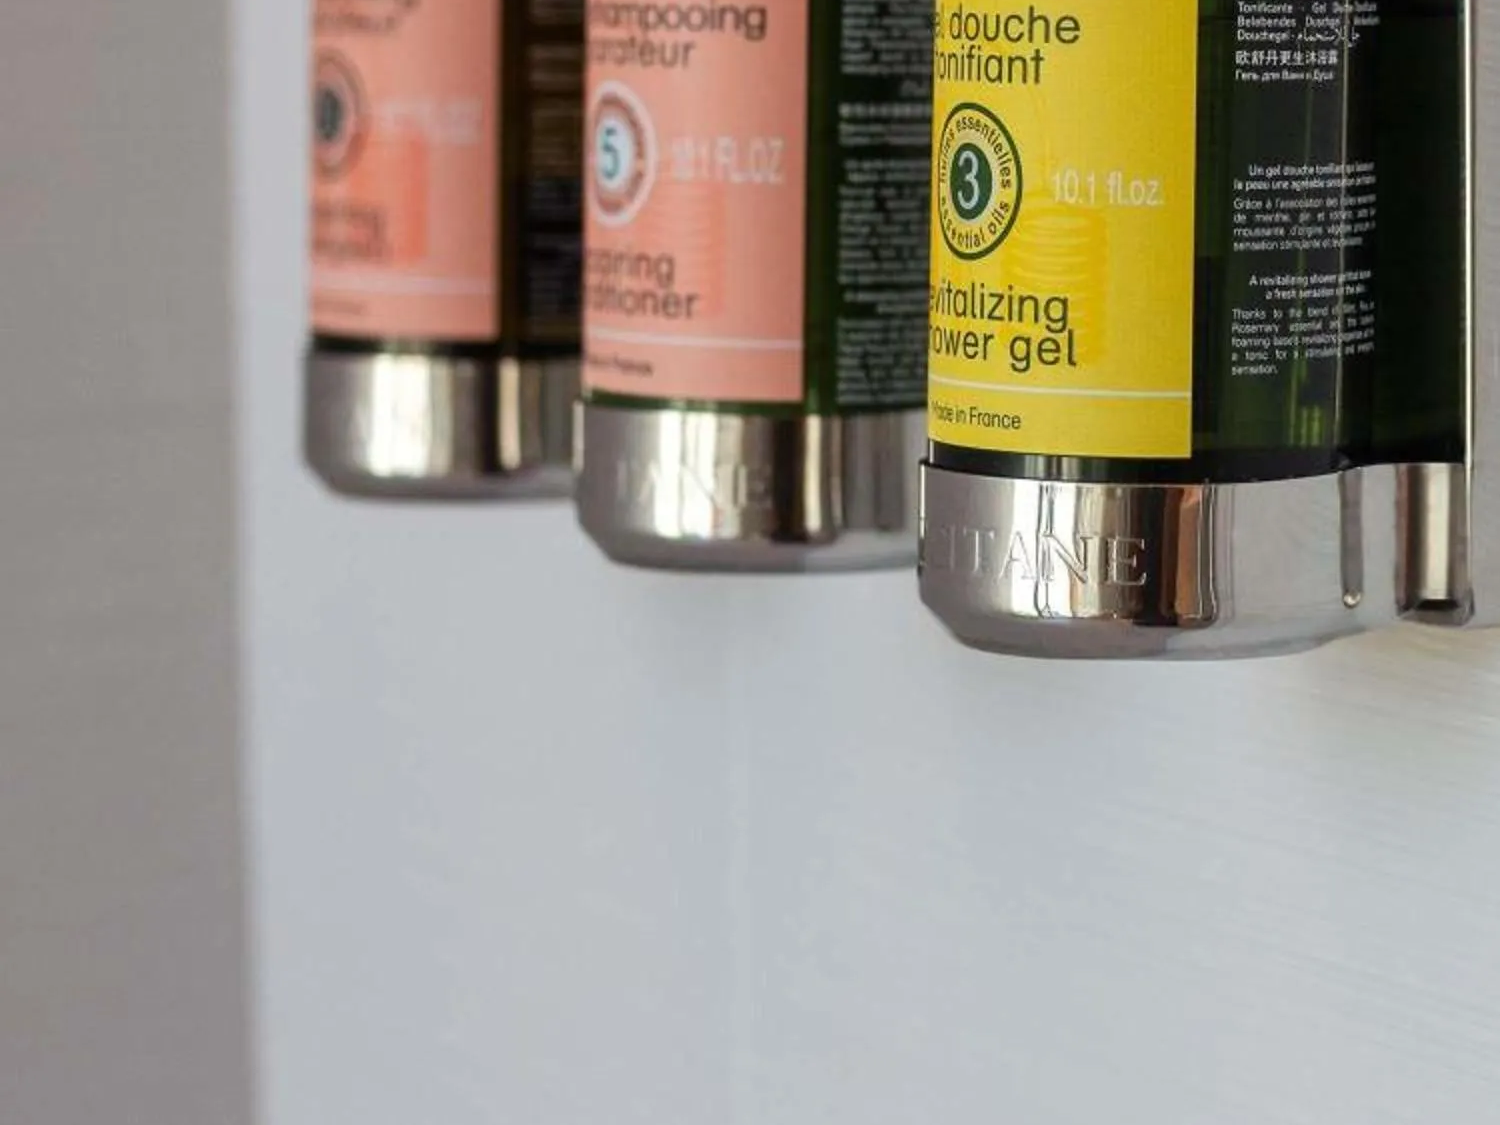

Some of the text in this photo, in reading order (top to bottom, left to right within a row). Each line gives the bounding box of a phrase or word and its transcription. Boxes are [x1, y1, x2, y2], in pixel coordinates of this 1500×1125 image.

[1237, 1, 1293, 13] Tonificante
[1311, 2, 1327, 13] Gel
[949, 3, 1081, 44] douche
[1237, 15, 1297, 28] Belebendes
[935, 43, 1045, 85] onifiant
[600, 126, 622, 181] 5
[955, 116, 1013, 190] essentielles
[956, 149, 981, 210] 3
[1248, 163, 1264, 176] Un
[1265, 164, 1281, 178] gel
[1052, 169, 1095, 204] 10.1
[1245, 180, 1270, 191] peau
[1271, 179, 1288, 190] une
[987, 200, 1010, 236] oils
[1233, 212, 1247, 224] de
[1248, 275, 1258, 286] A
[1231, 308, 1266, 320] Thanks
[1272, 308, 1283, 319] to
[929, 325, 1077, 373] ower gel
[1231, 336, 1271, 349] foaming
[1275, 349, 1287, 360] for
[955, 405, 967, 424] in
[969, 406, 1022, 430] France
